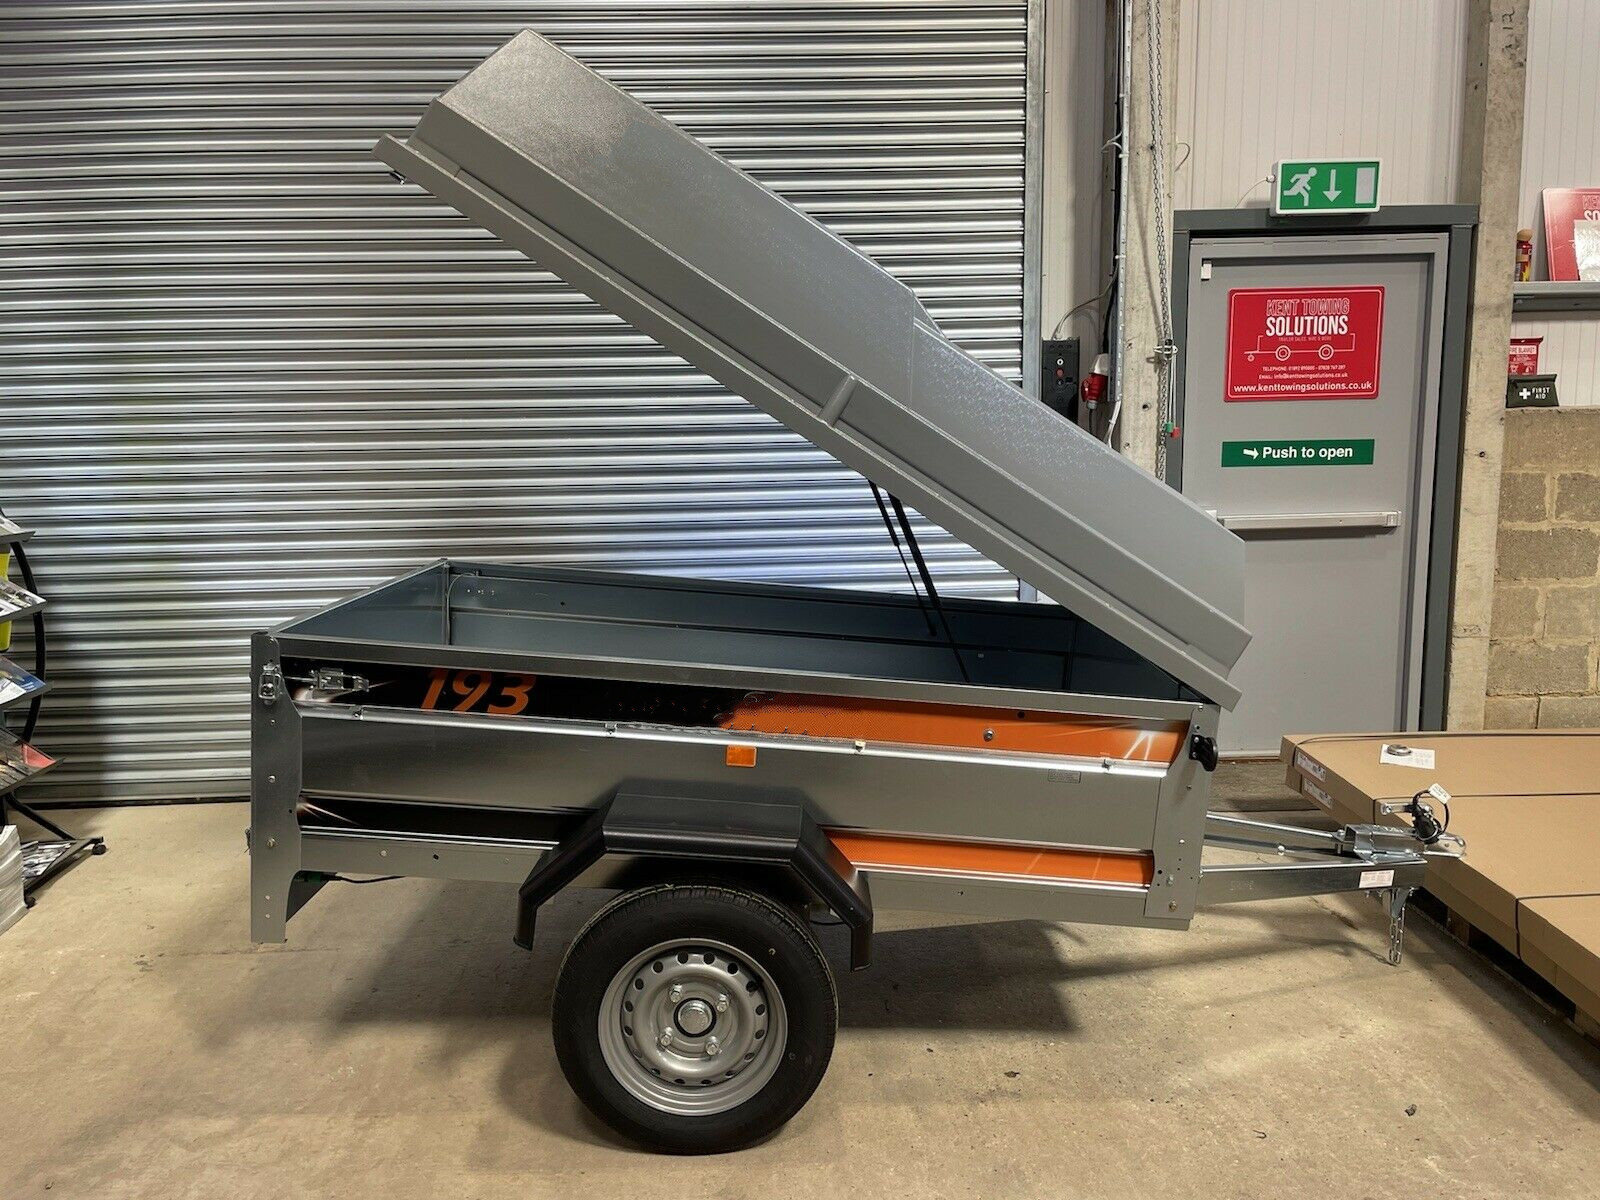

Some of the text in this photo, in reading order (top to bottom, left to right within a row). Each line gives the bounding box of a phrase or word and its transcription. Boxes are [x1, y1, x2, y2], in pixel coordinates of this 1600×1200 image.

[1266, 298, 1350, 316] KENT TOWING
[1266, 315, 1349, 336] SOLUTIONS
[1234, 381, 1372, 393] www.kenttowingsolutions.co.uk
[1262, 446, 1353, 460] Push to open
[421, 667, 536, 715] 193
